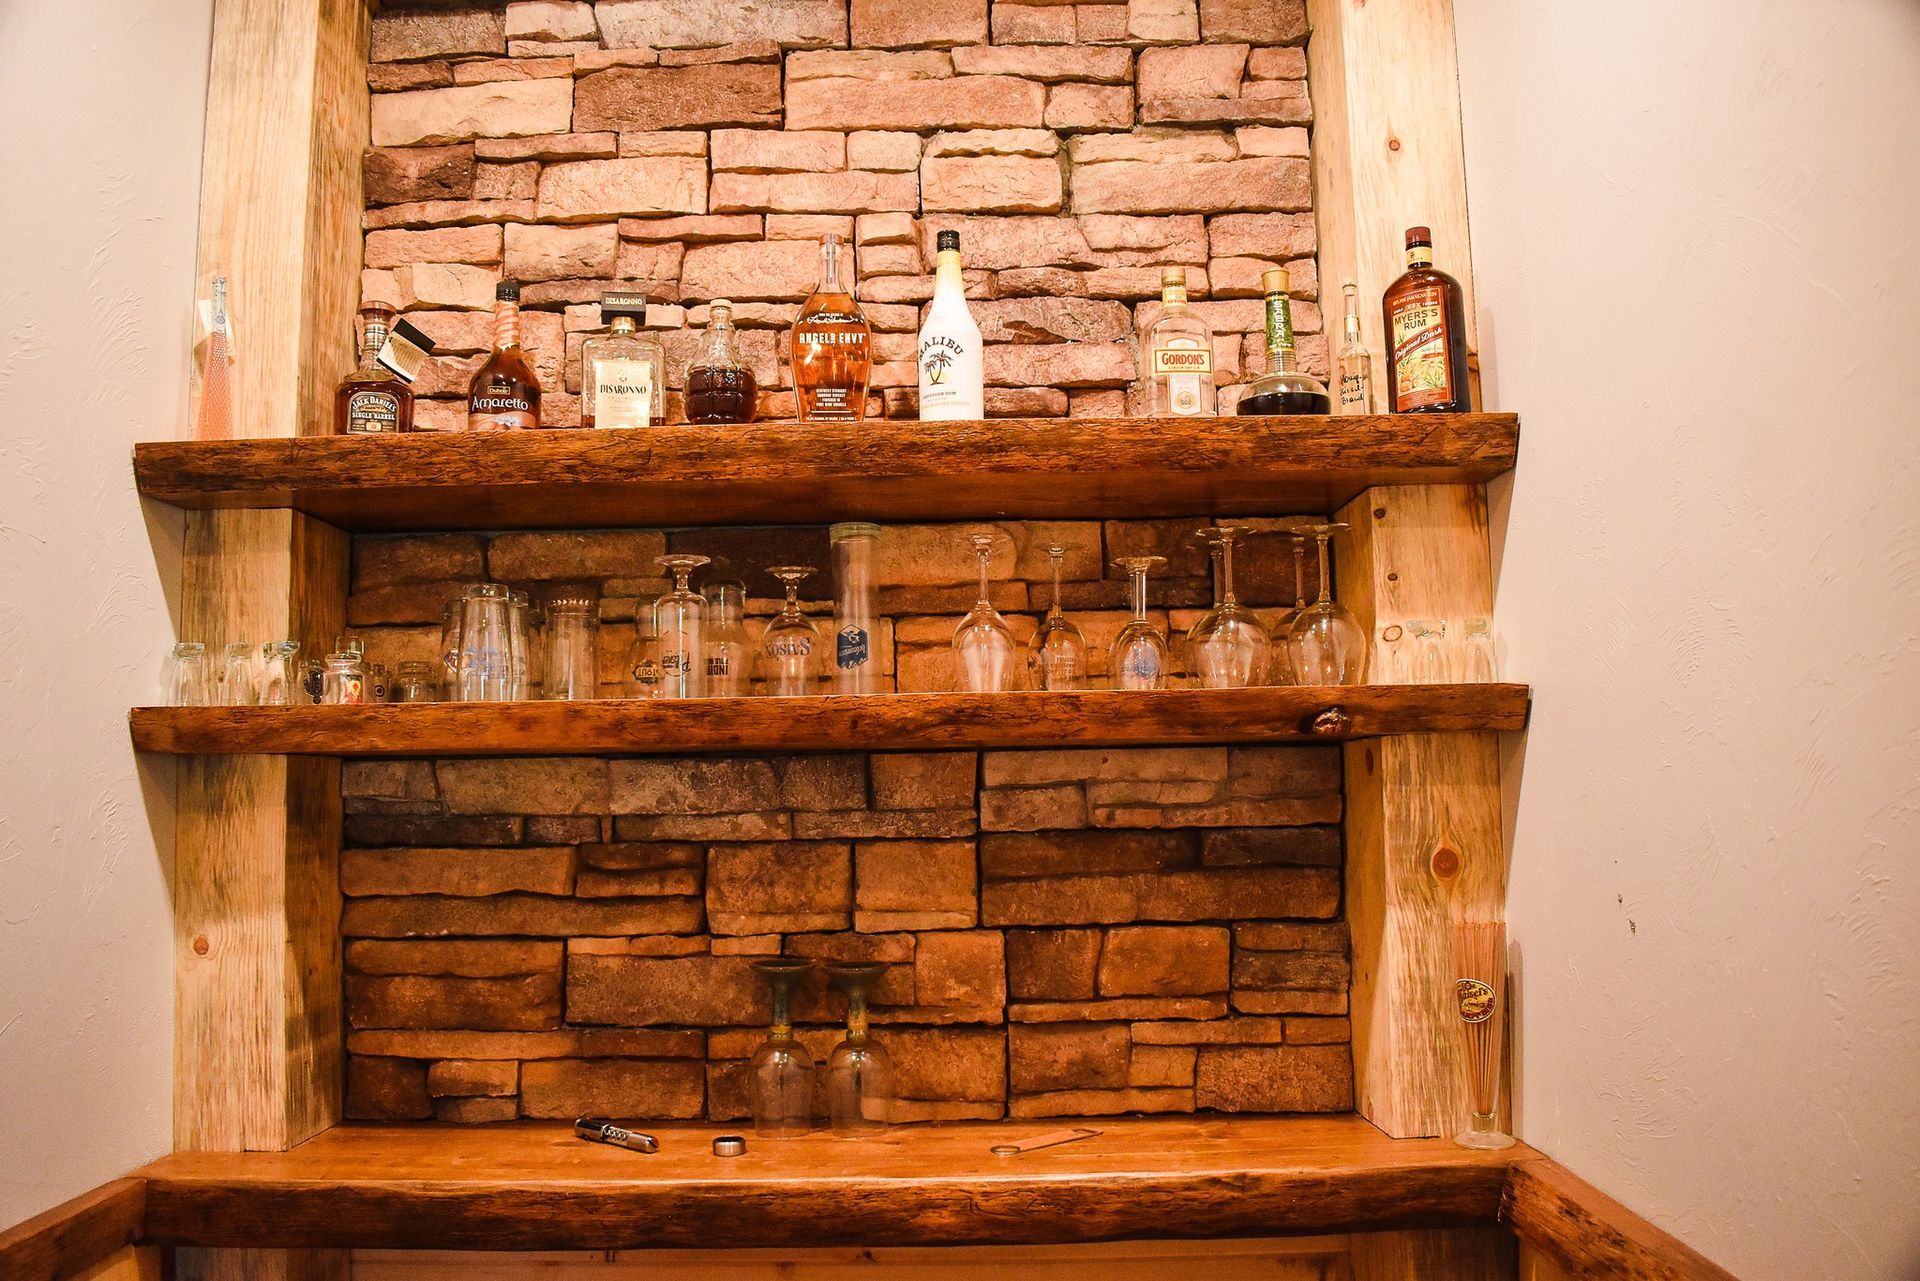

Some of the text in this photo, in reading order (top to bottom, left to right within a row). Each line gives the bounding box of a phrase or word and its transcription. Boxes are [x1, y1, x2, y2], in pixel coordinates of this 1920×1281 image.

[605, 297, 643, 306] DISARONNO
[1395, 309, 1438, 326] MYERS'S
[1404, 319, 1426, 331] RUM
[839, 332, 865, 344] ENVY
[1395, 326, 1443, 360] Original Dark
[919, 336, 964, 361] MALIBU
[600, 384, 647, 394] DISARONNO
[351, 398, 370, 410] JACK
[472, 396, 528, 411] Amaretto
[352, 411, 396, 421] SINGLE BARREL
